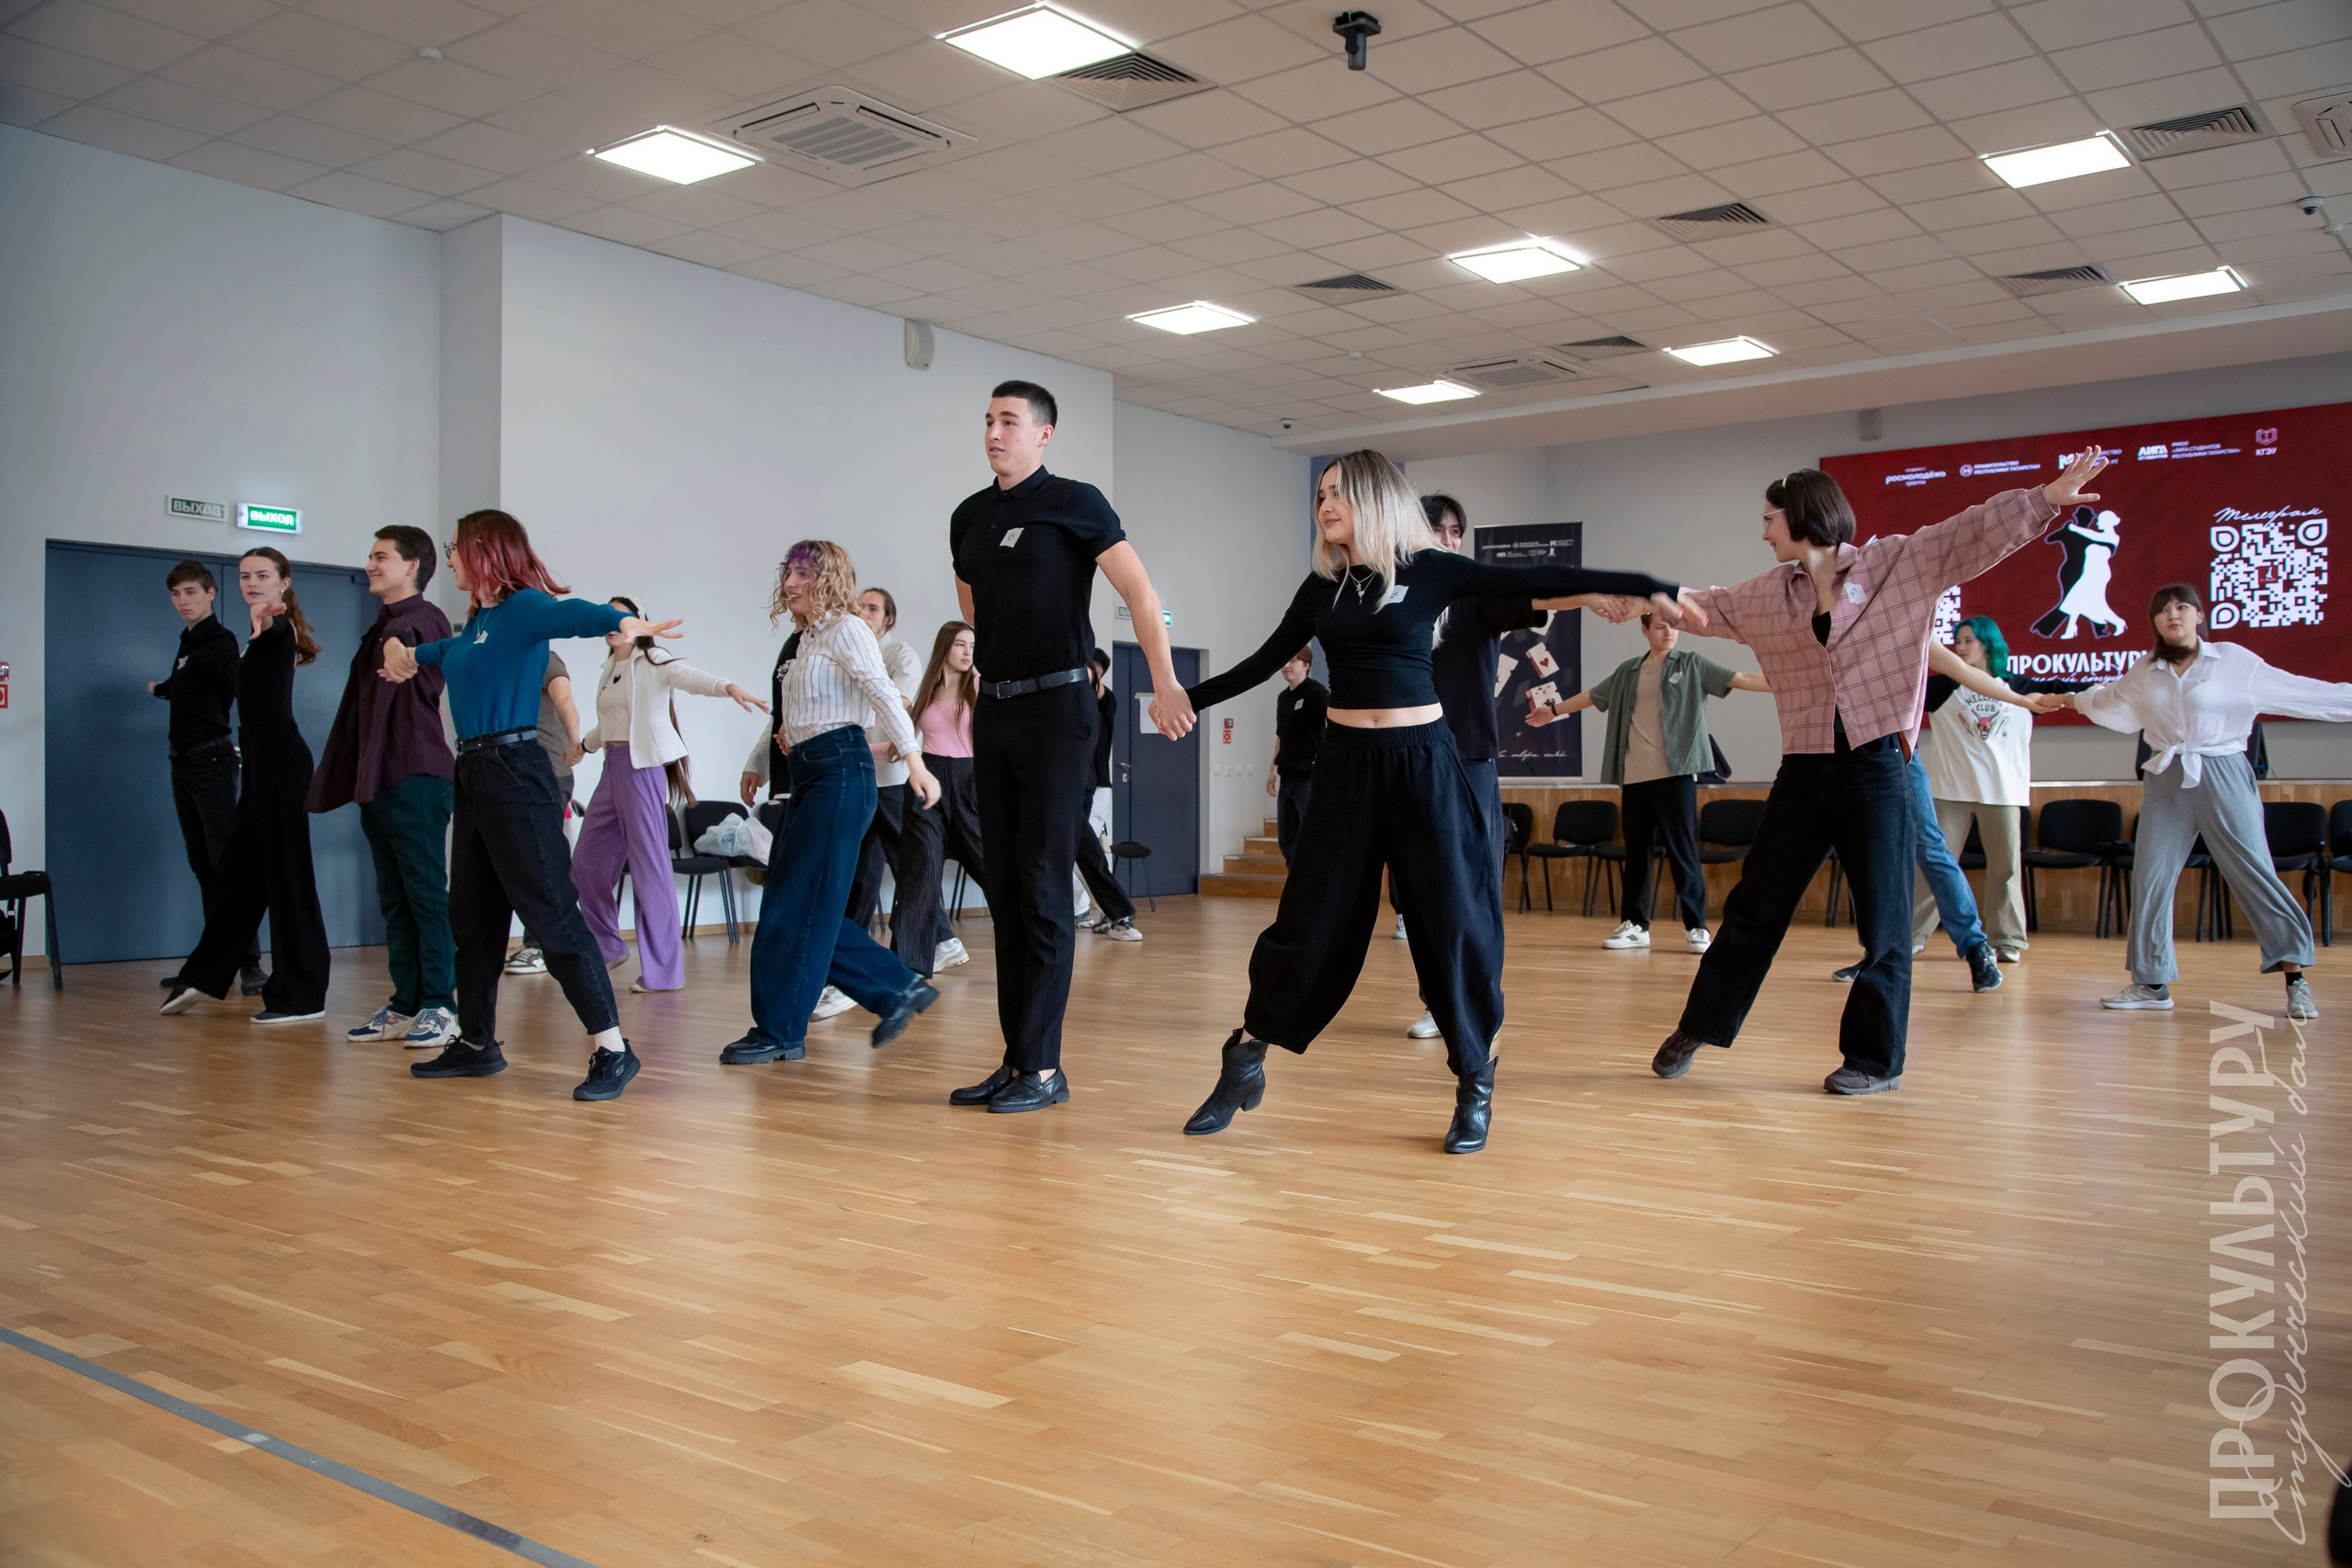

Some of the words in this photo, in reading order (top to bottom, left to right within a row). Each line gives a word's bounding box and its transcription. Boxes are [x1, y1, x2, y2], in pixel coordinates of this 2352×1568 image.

[2137, 445, 2168, 457] ЛИГА
[2255, 446, 2278, 457] КГЭУ
[173, 500, 222, 518] ВЫХОД
[249, 510, 295, 526] ВЫХОД
[2006, 649, 2148, 675] ПРОКУЛЬТУР
[1975, 704, 1996, 713] CLUB
